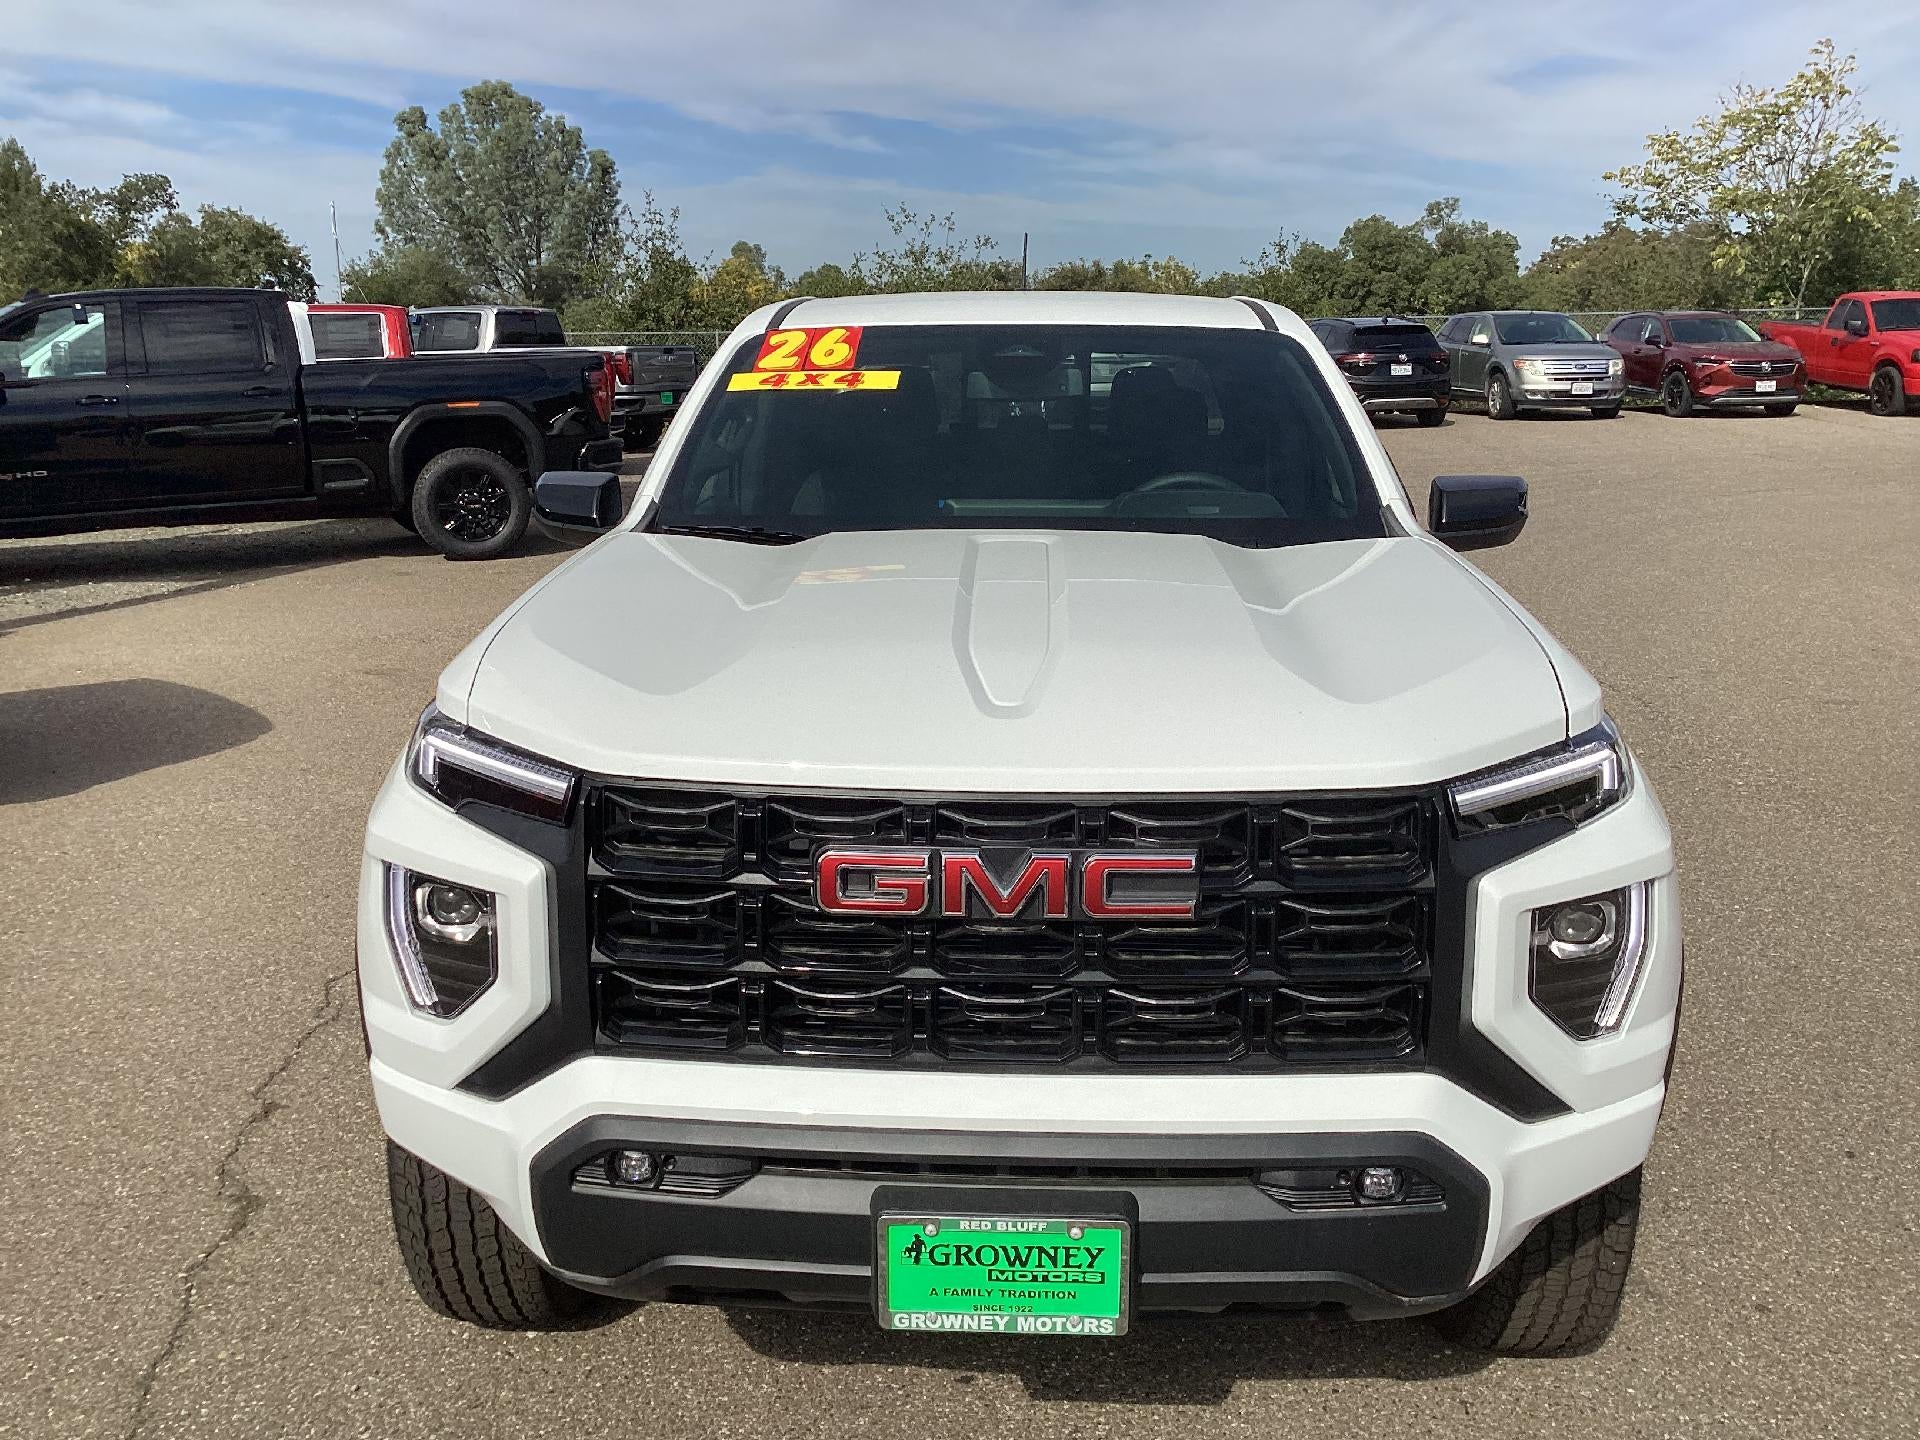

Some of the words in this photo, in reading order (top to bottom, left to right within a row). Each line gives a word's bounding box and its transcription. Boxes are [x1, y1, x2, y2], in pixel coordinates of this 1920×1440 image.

[757, 328, 853, 370] 26
[816, 849, 1197, 920] GMC
[959, 1220, 992, 1231] RED
[996, 1221, 1048, 1232] BLUFF
[928, 1242, 1106, 1269] GROWNEY
[991, 1270, 1102, 1283] MOTORS
[928, 1287, 938, 1297] A
[943, 1287, 994, 1298] FAMILY
[998, 1289, 1077, 1300] TRADITION
[972, 1304, 1005, 1312] SINCE
[1008, 1305, 1034, 1313] 1922
[893, 1313, 1009, 1332] GROWNEY
[1016, 1315, 1114, 1334] MOTORS
